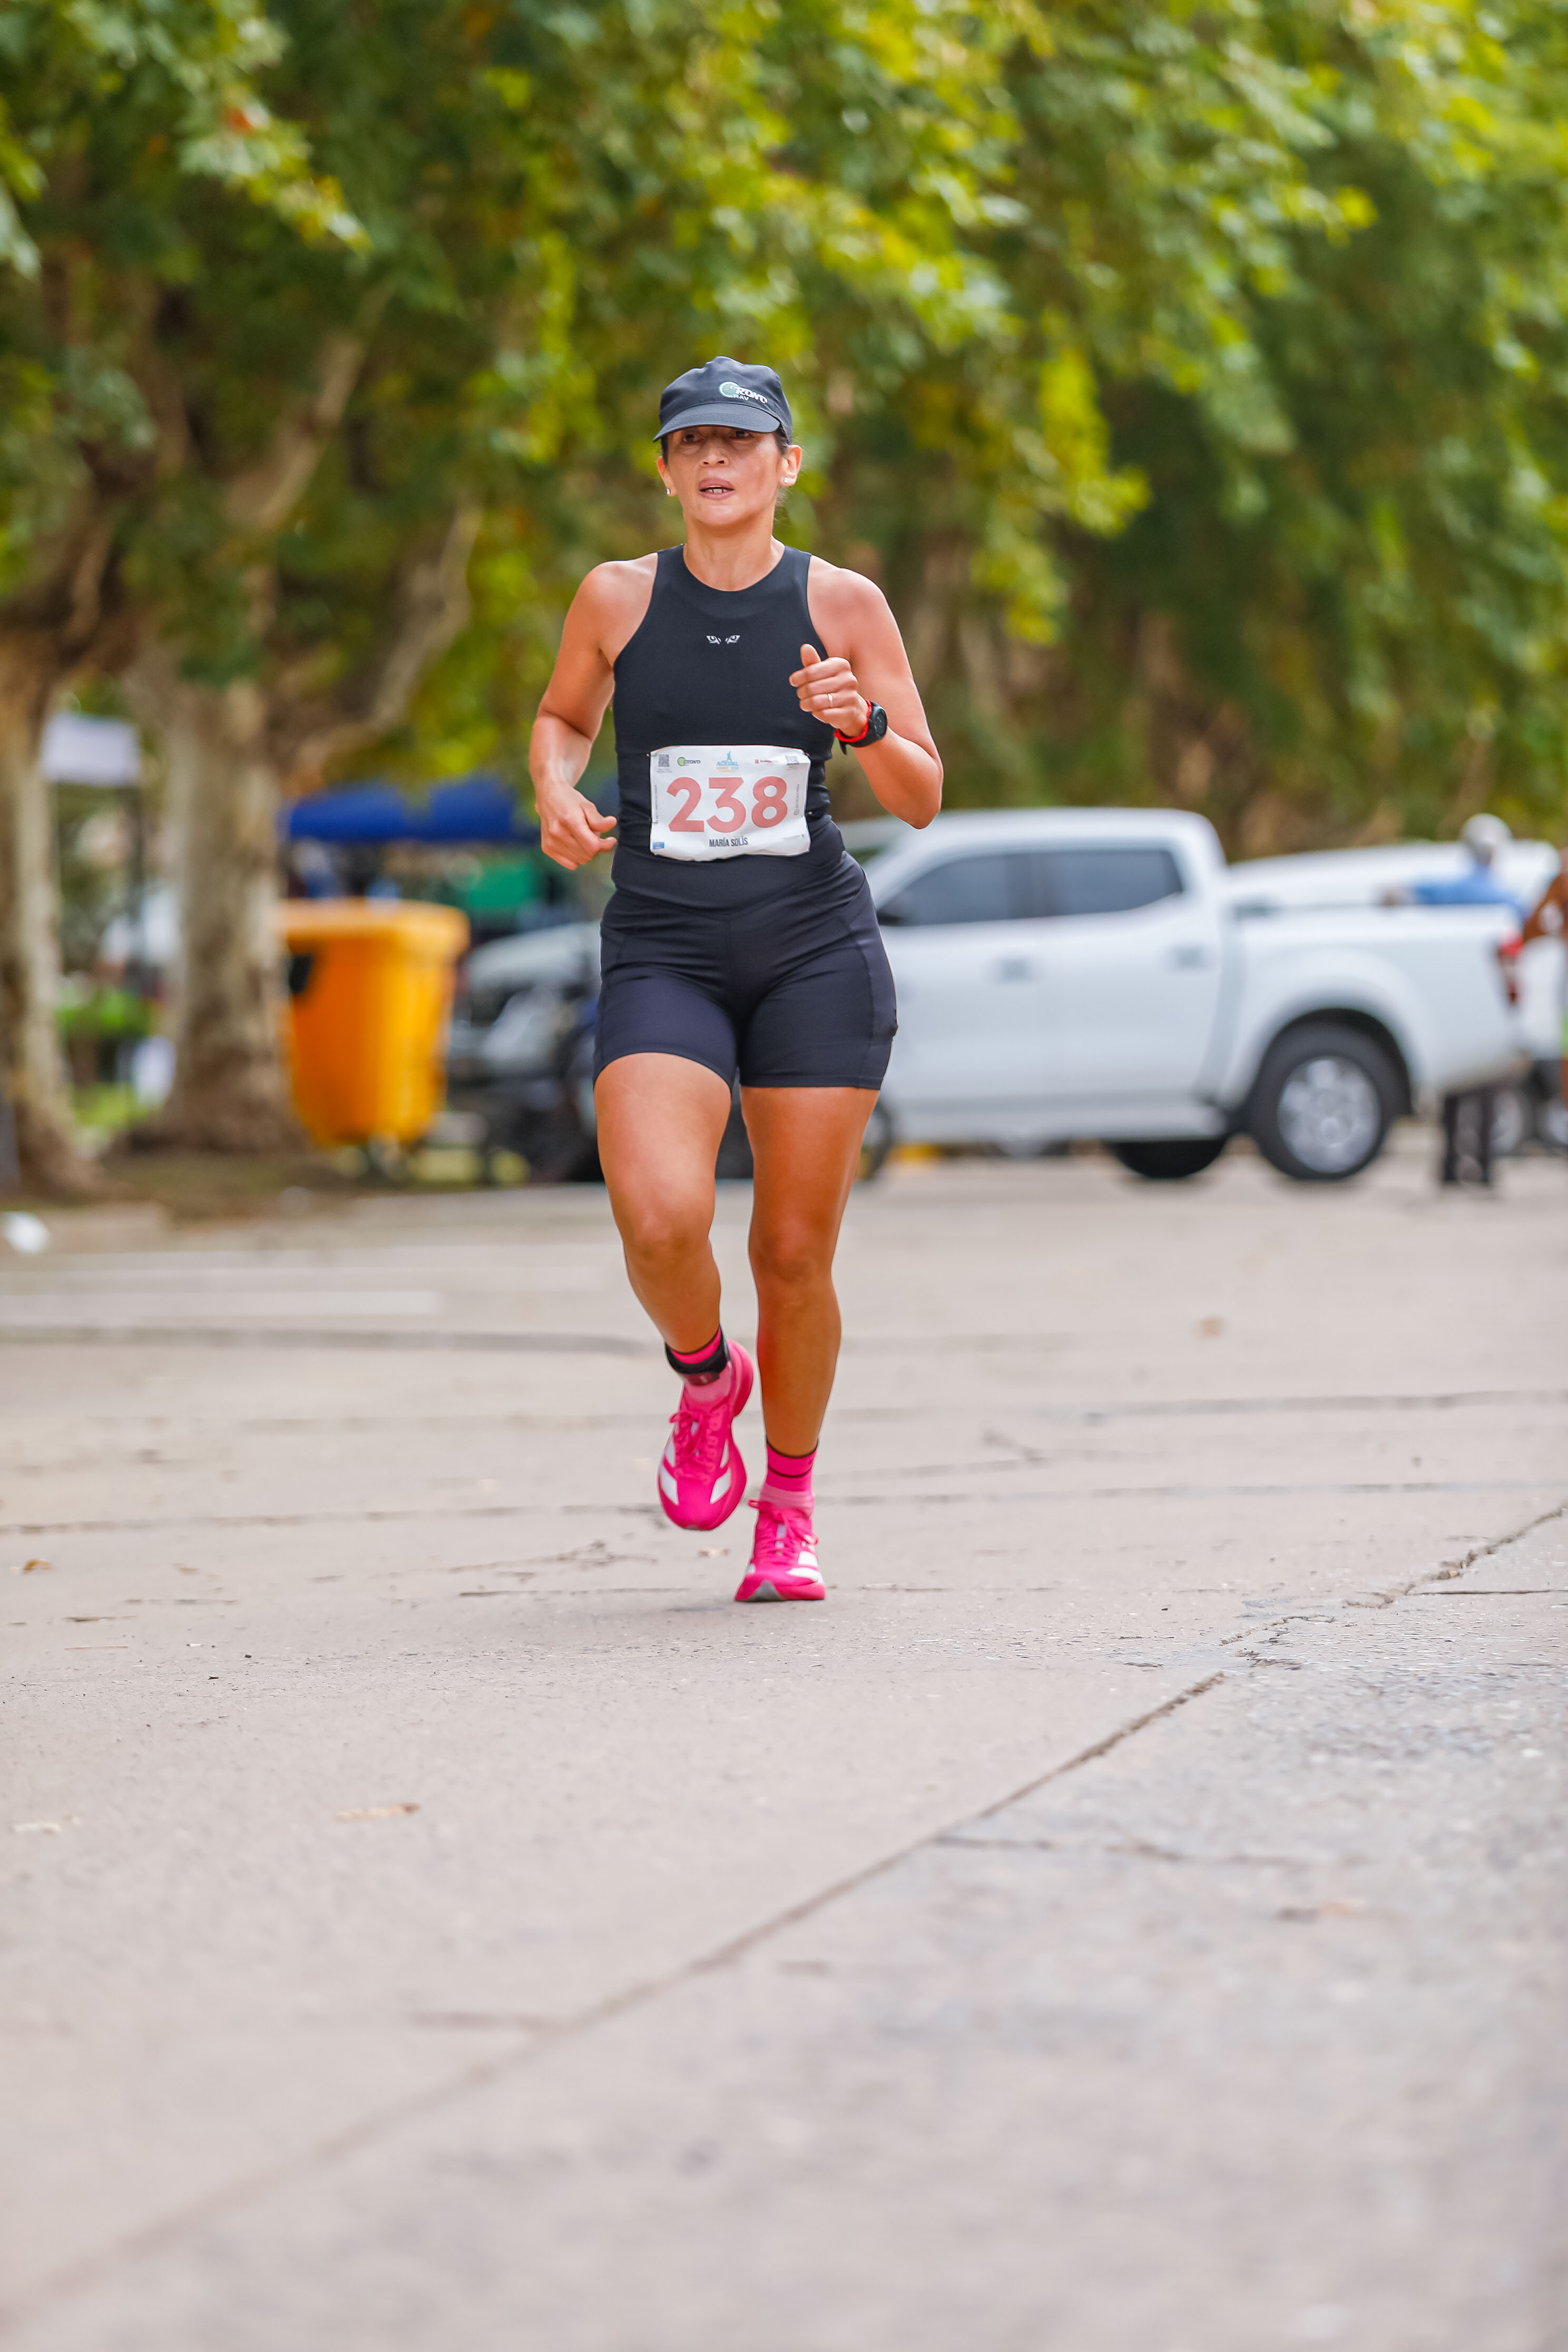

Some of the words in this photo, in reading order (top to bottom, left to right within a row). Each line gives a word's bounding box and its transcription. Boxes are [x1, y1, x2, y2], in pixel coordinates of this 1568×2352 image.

[667, 776, 788, 833] 238
[709, 837, 729, 847] MARÍA
[731, 836, 748, 846] SOLÍS
